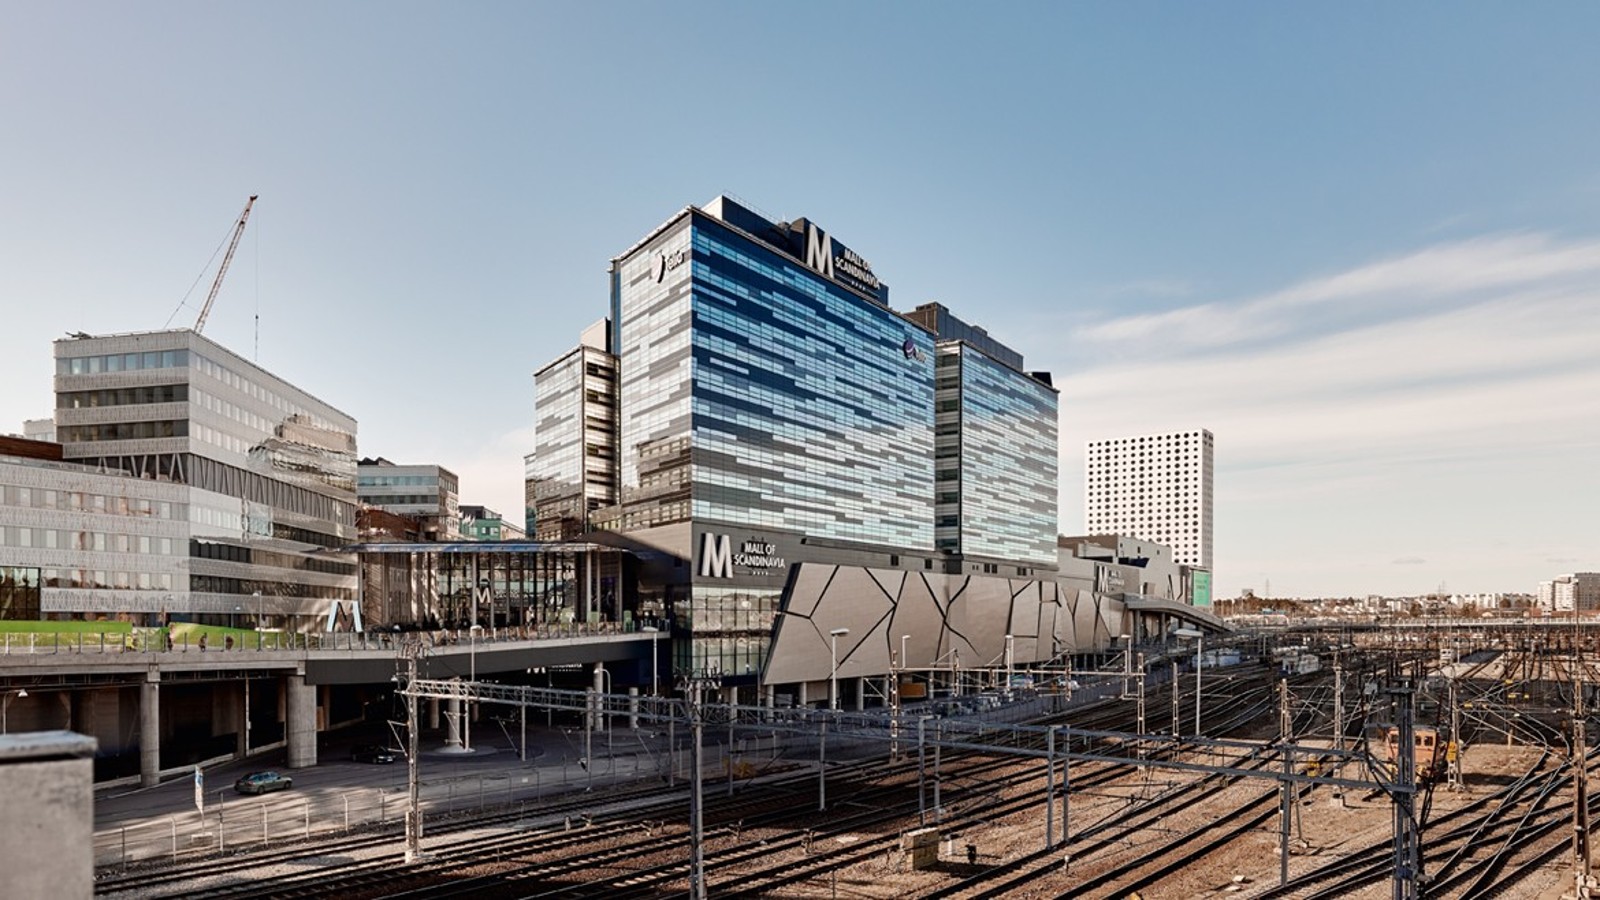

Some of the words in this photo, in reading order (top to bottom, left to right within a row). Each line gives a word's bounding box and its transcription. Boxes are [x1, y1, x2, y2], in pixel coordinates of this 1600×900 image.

[807, 223, 834, 279] M
[844, 248, 863, 267] MALL
[835, 256, 881, 290] SCANDINAVIA
[702, 533, 733, 578] M
[745, 542, 764, 554] MALL
[765, 544, 776, 555] OF
[734, 555, 785, 568] SCANDINAVIA
[476, 587, 491, 603] M
